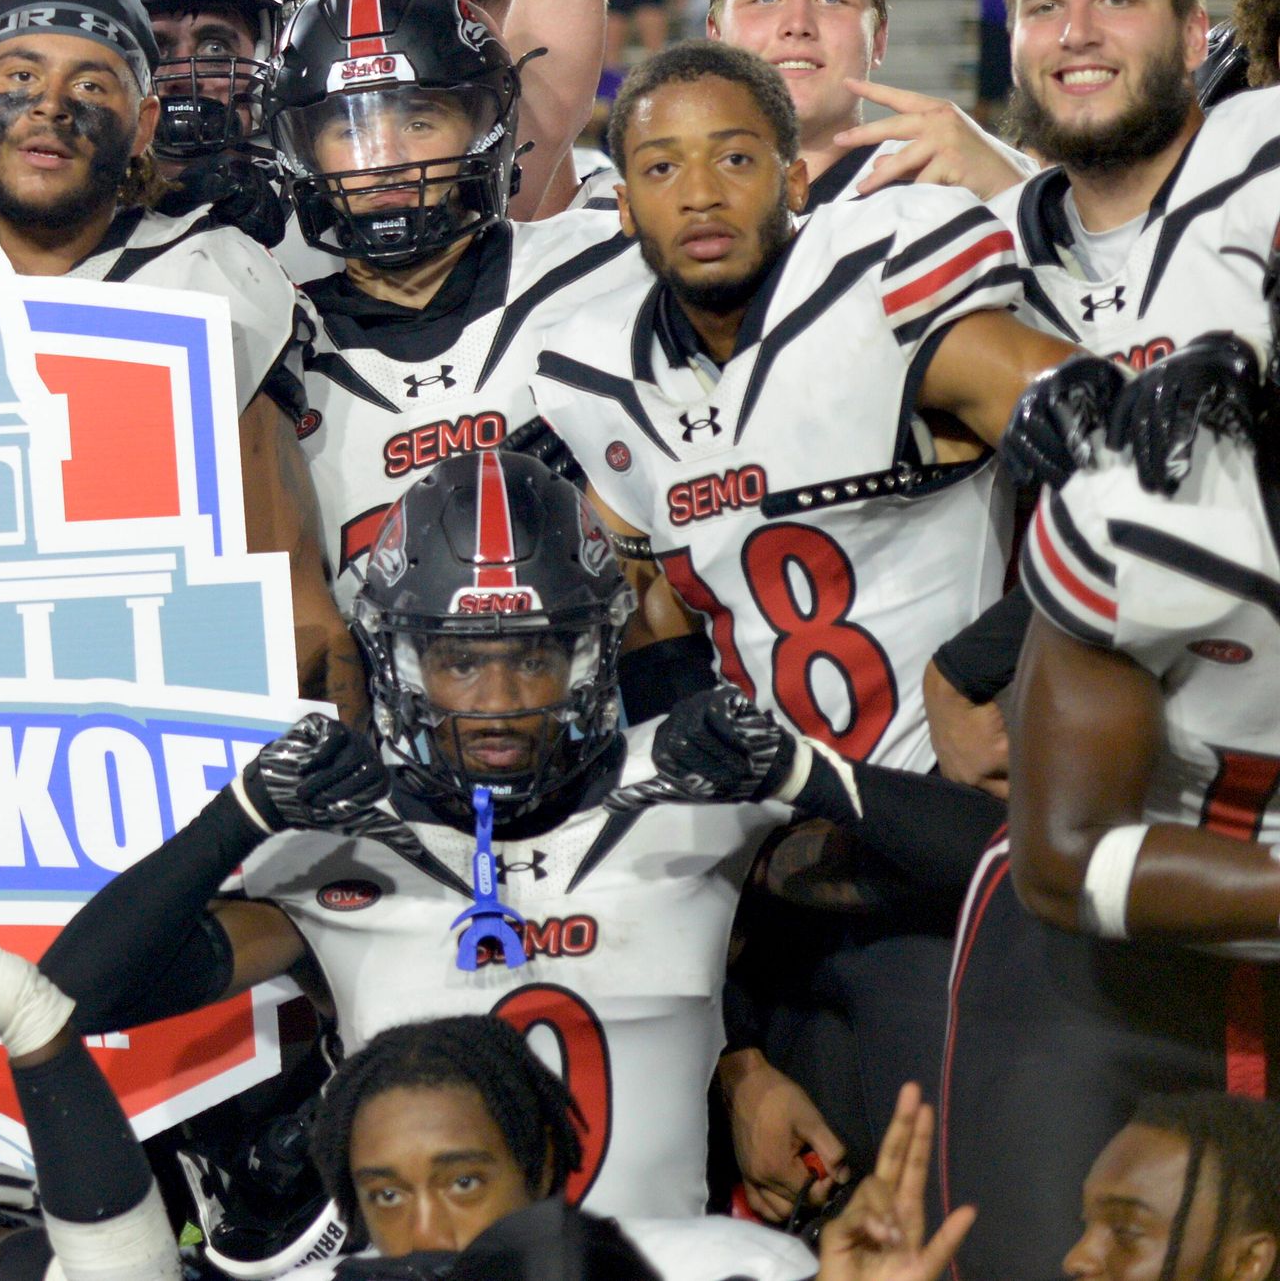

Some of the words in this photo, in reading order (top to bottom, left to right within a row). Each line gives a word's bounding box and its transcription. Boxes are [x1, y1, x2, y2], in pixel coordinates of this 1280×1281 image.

[372, 218, 407, 230] Riddell
[384, 411, 507, 478] SEMO
[667, 464, 768, 527] SEMO
[458, 594, 532, 614] SEMO
